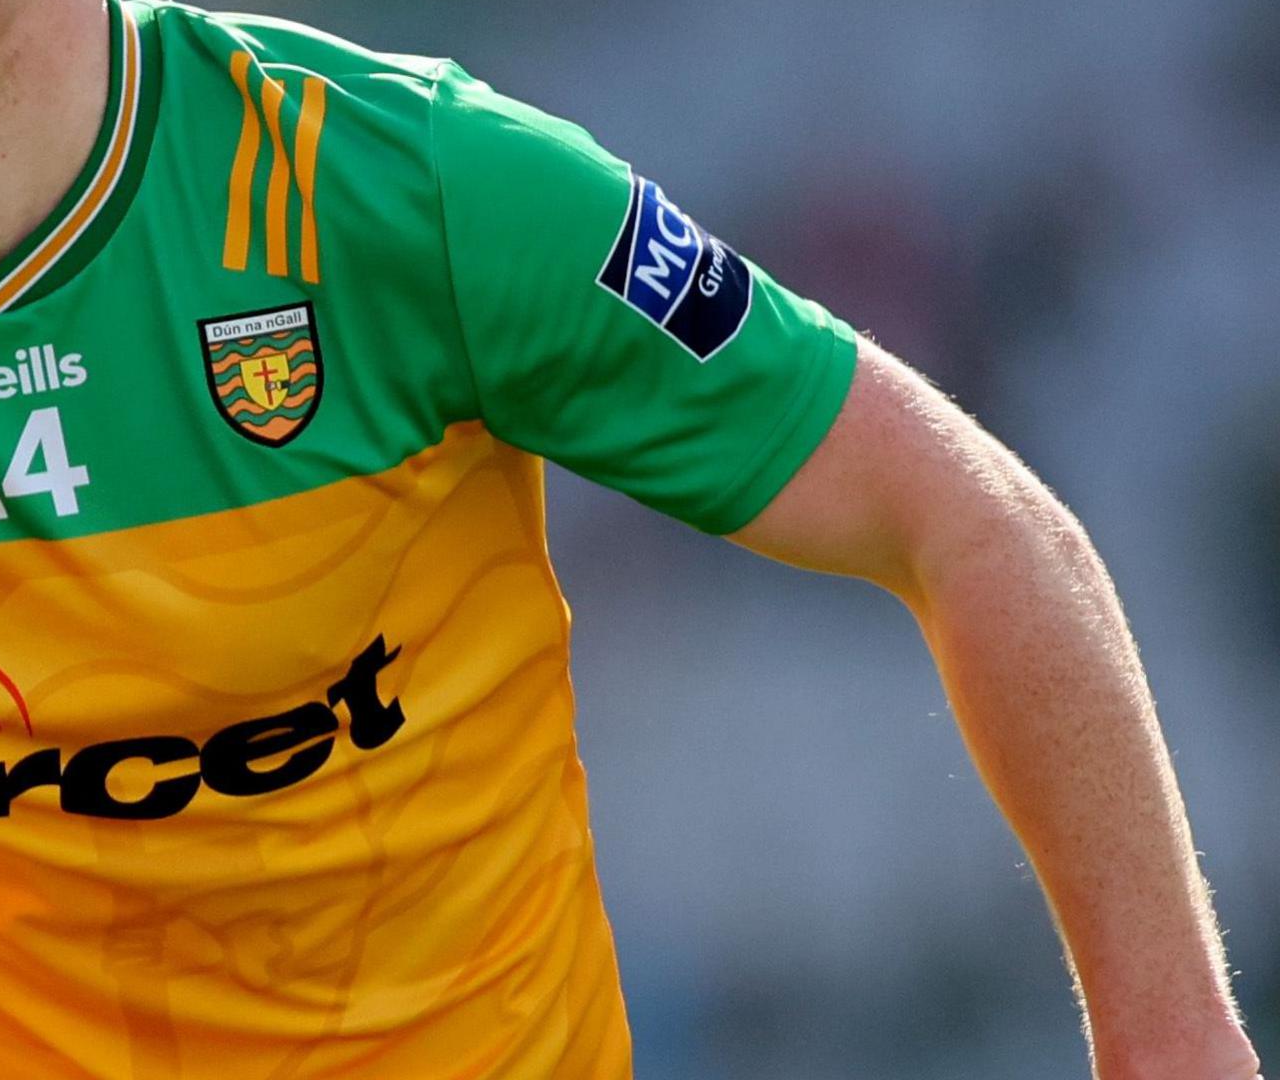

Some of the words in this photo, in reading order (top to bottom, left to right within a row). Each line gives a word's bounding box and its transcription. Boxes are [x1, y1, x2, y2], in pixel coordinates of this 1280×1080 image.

[212, 323, 241, 339] Dún
[245, 321, 262, 332] na
[266, 311, 301, 328] nGall
